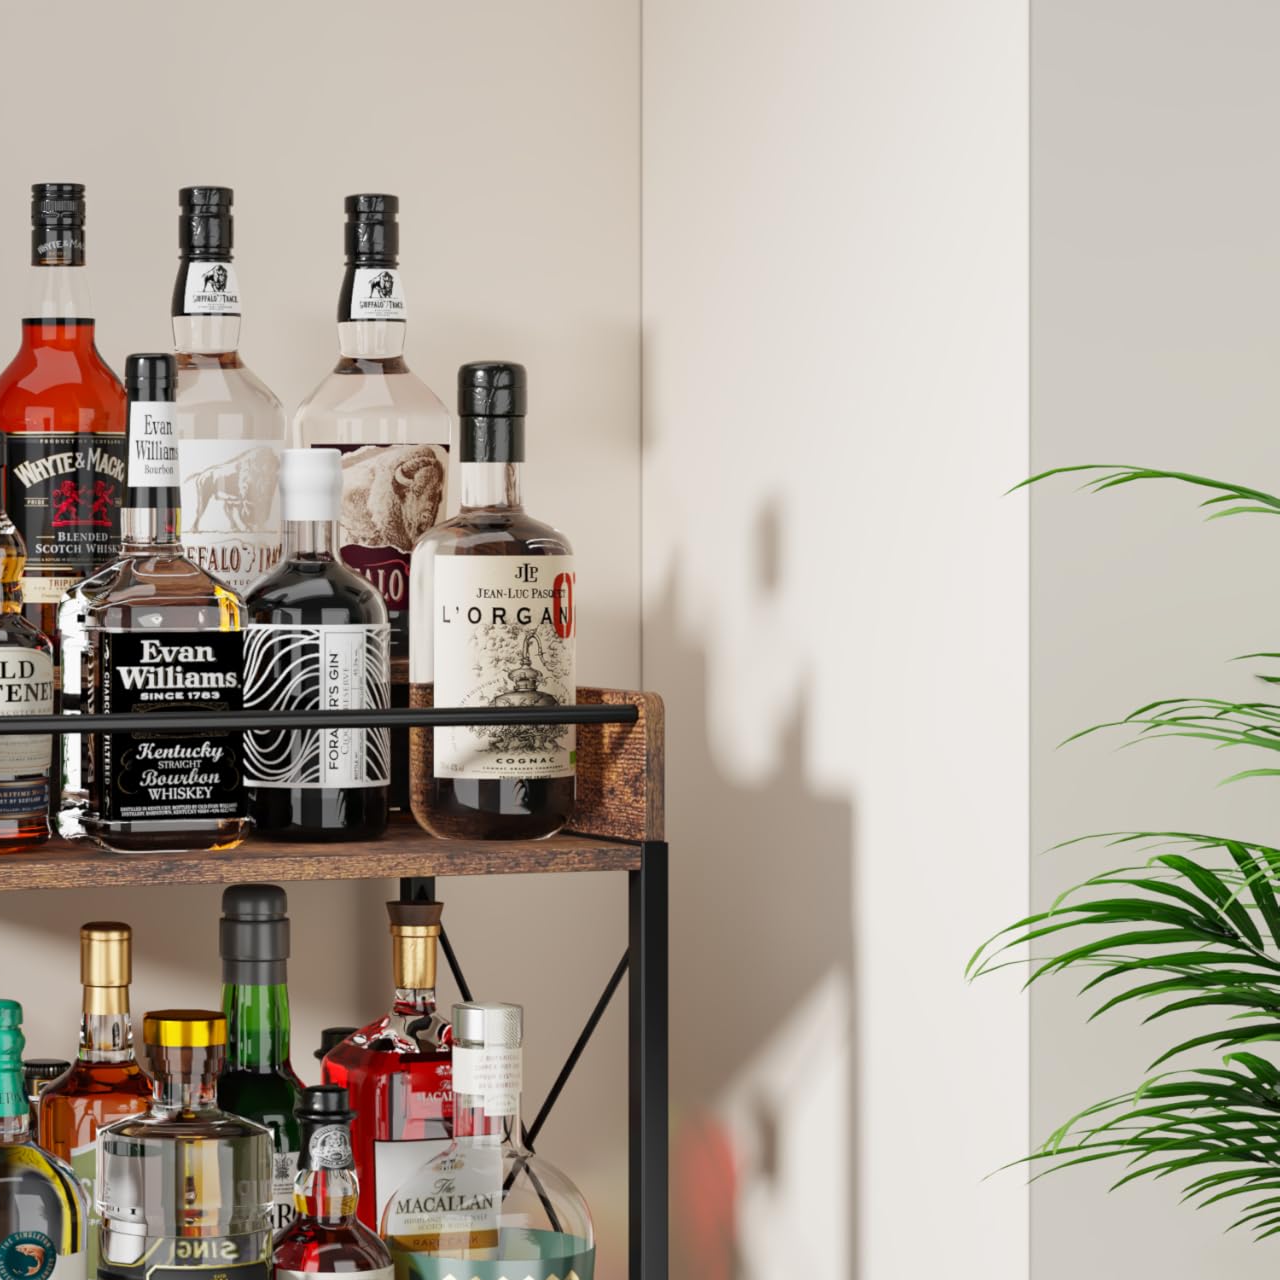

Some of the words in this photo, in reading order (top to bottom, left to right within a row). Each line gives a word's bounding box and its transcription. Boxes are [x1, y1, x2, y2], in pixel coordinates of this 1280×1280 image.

[144, 414, 173, 435] Evan
[13, 451, 76, 489] WHYTE
[75, 451, 86, 470] &
[144, 464, 174, 475] Bourbon
[57, 531, 109, 542] BLENDED
[35, 543, 82, 554] SCOTCH
[476, 588, 529, 599] JEAN-LUC
[140, 639, 217, 664] Evan
[329, 653, 339, 680] GIN
[140, 692, 184, 701] SINCE
[187, 691, 221, 700] 1783
[329, 685, 339, 770] FORAR'S
[135, 741, 224, 763] Kentucky
[157, 759, 202, 769] STRAIGHT
[139, 768, 221, 787] Bourbon
[147, 786, 214, 801] WHISKEY
[431, 1178, 455, 1194] The
[396, 1194, 493, 1215] MACALLAN
